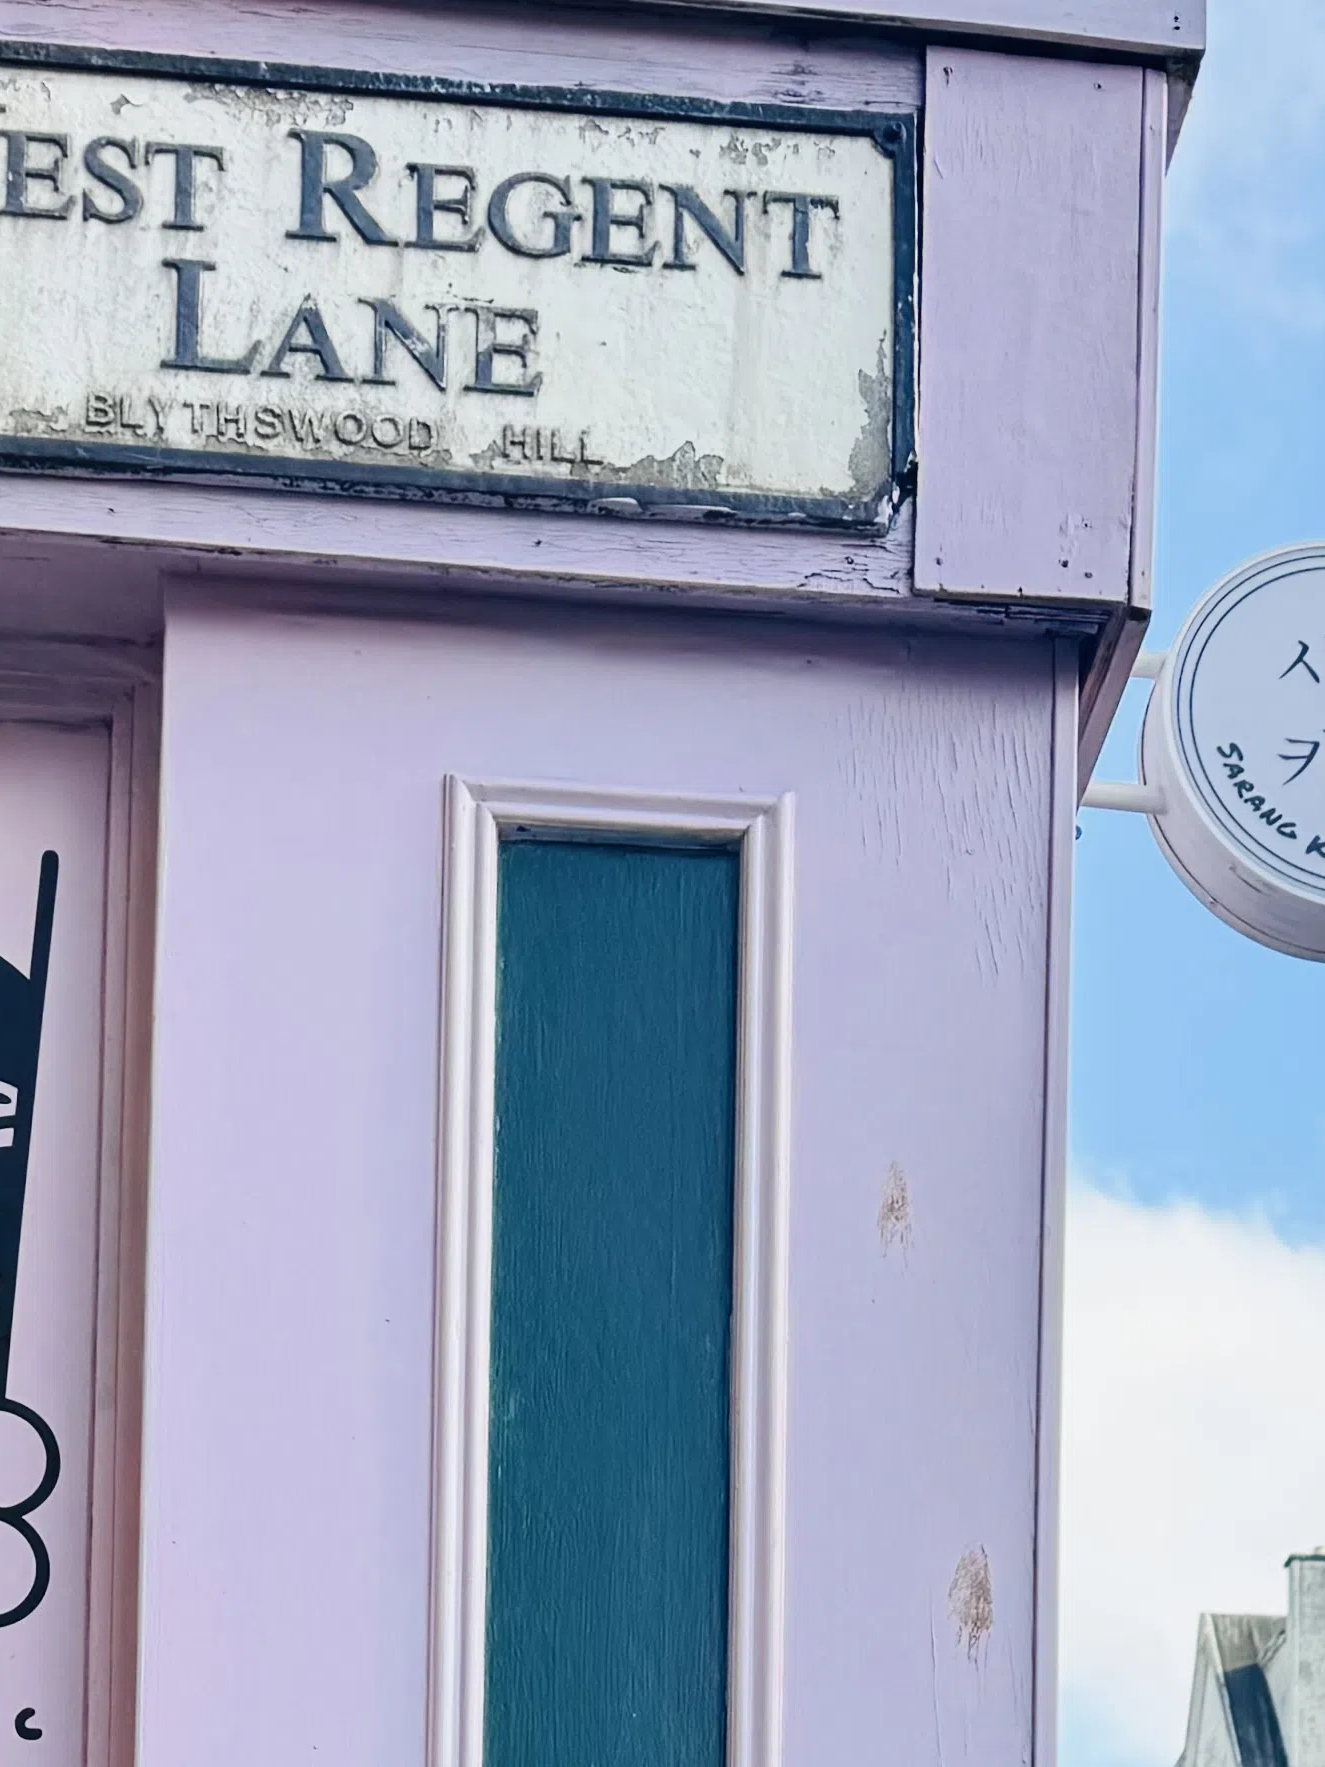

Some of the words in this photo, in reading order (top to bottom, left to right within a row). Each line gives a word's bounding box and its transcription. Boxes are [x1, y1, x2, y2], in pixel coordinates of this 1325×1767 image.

[286, 127, 841, 281] REGENT
[159, 256, 544, 398] LANE
[83, 390, 436, 455] BLYTHSWOOD
[501, 421, 605, 466] HILL
[1216, 742, 1298, 840] SARANG
